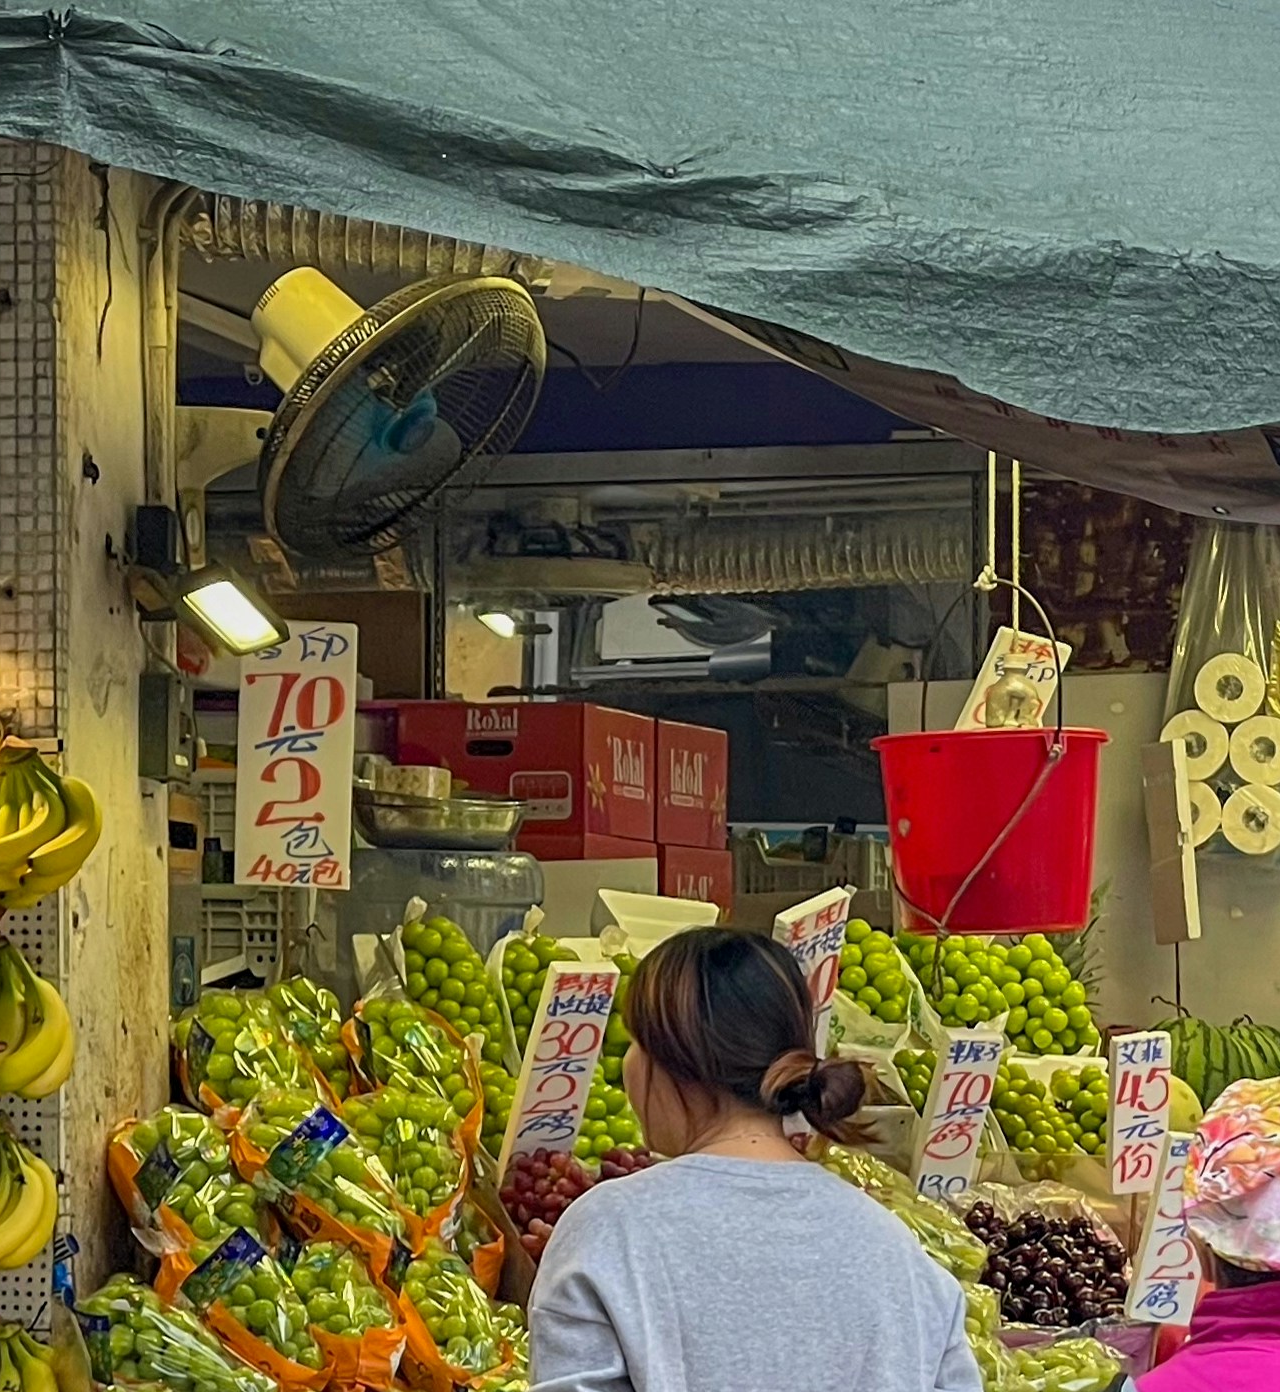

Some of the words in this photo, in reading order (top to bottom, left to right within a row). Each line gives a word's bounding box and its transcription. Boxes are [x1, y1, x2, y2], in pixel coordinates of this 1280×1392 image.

[245, 672, 346, 739] 70
[255, 725, 325, 755] 元
[255, 757, 325, 826] 2
[281, 821, 334, 858] 包
[246, 855, 343, 887] 40元包
[533, 1020, 601, 1063] 30
[531, 1057, 589, 1075] 元
[522, 1073, 579, 1115] 2
[943, 1071, 992, 1114] 70
[1116, 1067, 1171, 1113] 45
[1117, 1115, 1165, 1140] 元
[1112, 1142, 1158, 1184] 份
[1145, 1239, 1195, 1281] 2
